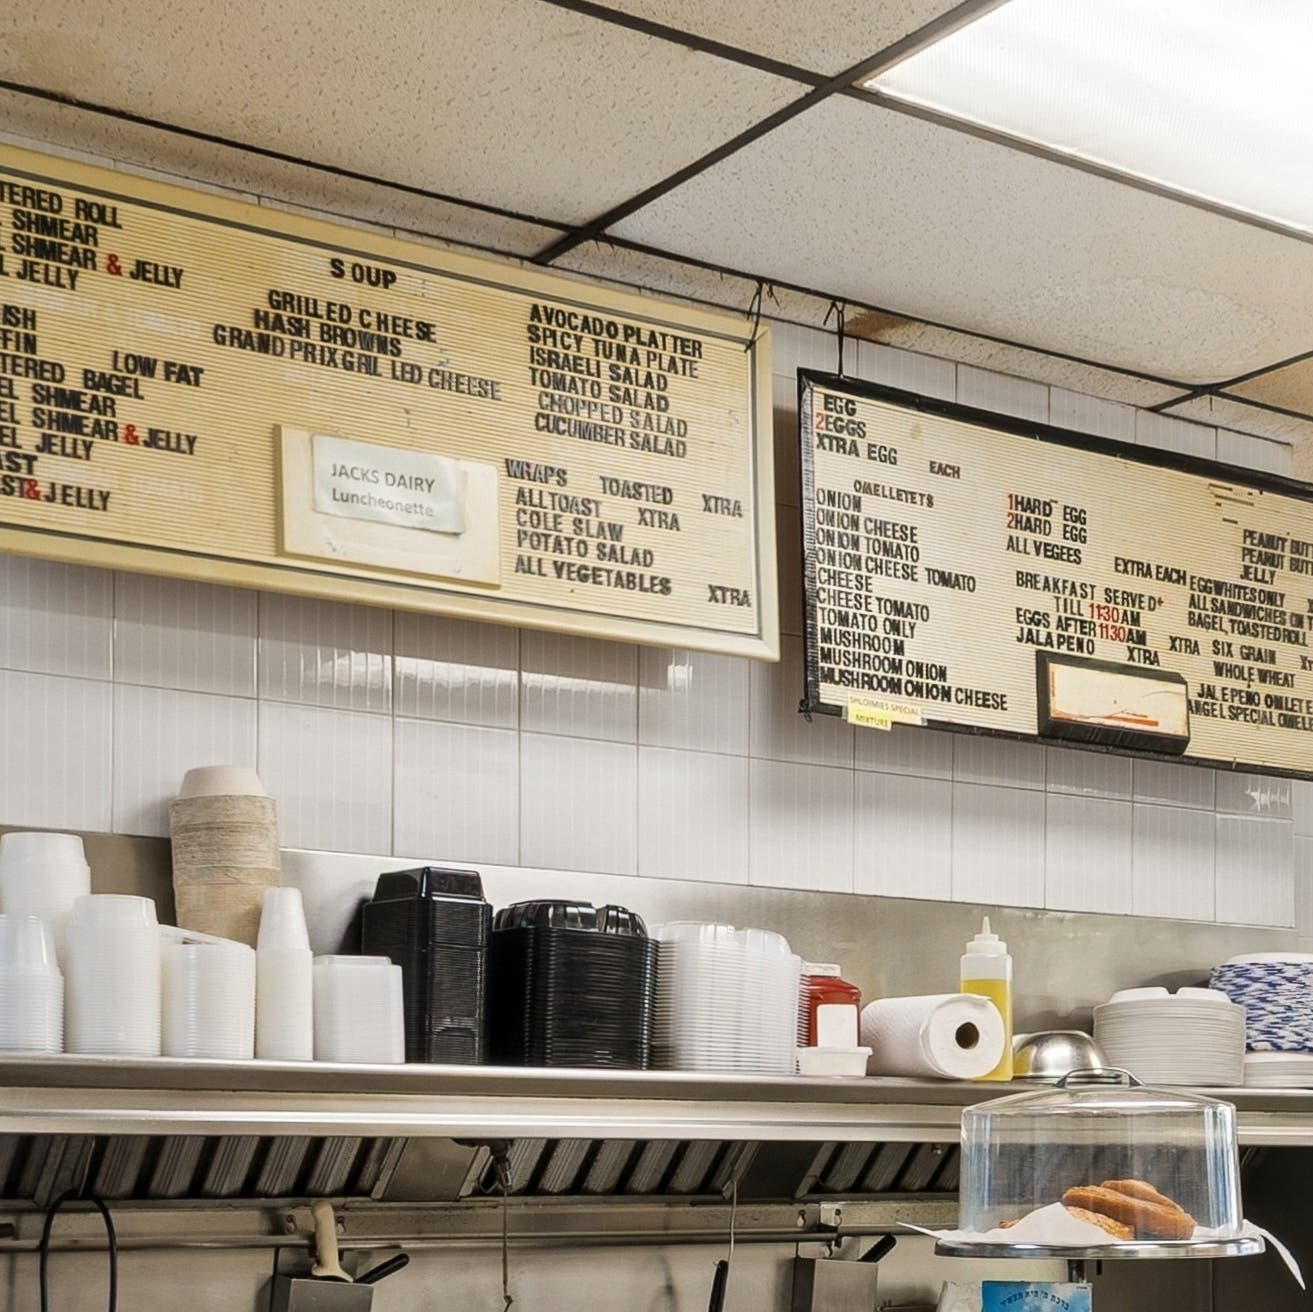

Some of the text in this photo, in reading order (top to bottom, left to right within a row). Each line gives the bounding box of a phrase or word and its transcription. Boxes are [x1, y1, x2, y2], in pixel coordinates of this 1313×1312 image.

[12, 209, 99, 247] SHMEAR
[74, 198, 123, 229] ROLL
[12, 233, 184, 289] SHMEAR & JELLY
[16, 259, 79, 290] JELLY
[330, 258, 397, 289] SOUP
[268, 289, 437, 343] GRILLED CHEESE
[530, 304, 703, 359] AVOCADO PLATTER
[253, 308, 402, 357] HASH BROWNS
[212, 324, 285, 358] GRAND
[289, 341, 338, 369] PRIX
[428, 368, 503, 401] CHEESE
[527, 324, 699, 379] SPICY TUNA PLATE
[83, 368, 145, 400] BAGEL
[112, 350, 204, 387] LOW FAT
[530, 346, 668, 392] ISRAELI SALAD
[32, 383, 117, 418] SHMEAR
[528, 367, 669, 413] TOMATO SALAD
[823, 393, 857, 417] EGG
[538, 391, 688, 438] CHOPPED SALAD
[32, 407, 119, 442] SHMEAR
[124, 424, 140, 445] &
[143, 427, 197, 455] JELLY
[36, 432, 94, 461] JELLY
[535, 412, 687, 458] CUCUMBER SALAD
[0, 451, 38, 475] ST
[816, 432, 898, 465] XTRA EGG
[331, 463, 435, 494] JACKS DAIRY
[929, 460, 960, 479] EACH
[45, 482, 110, 512] JELLY
[332, 487, 434, 518] Luncheonette
[599, 475, 672, 505] TOASTED
[702, 493, 743, 518] XTRA
[816, 487, 862, 512] ONION
[516, 508, 623, 543] COLE SLAW
[638, 507, 681, 532] XTRA
[816, 508, 918, 544] ONION CHEESE
[1063, 505, 1087, 526] EGG
[517, 529, 654, 568] POTATO SALAD
[815, 527, 919, 562] ONION TOMATO
[1006, 535, 1082, 565] ALL VEGEES
[1063, 523, 1087, 545] EGG
[1243, 529, 1287, 552] PEANUT
[816, 549, 976, 593] ONION CHEESE TOMATO
[1114, 556, 1187, 586] EXTRA EACH
[1242, 547, 1285, 569] PEANUT
[515, 554, 751, 608] ALL VEGETABLES XTRA
[817, 567, 872, 593] CHEESE
[1016, 570, 1157, 612] BREAKFAST SERVED
[1240, 565, 1276, 585] JELLY
[816, 587, 930, 622] CHEESE TOMATO
[1053, 596, 1084, 616] TILL
[1211, 597, 1286, 626] SANDWICHES
[818, 607, 916, 639] TOMATO ONLY
[1016, 607, 1050, 629] EGGS
[1056, 615, 1096, 637] AFTER
[820, 626, 905, 656] MUSHROOM
[1016, 627, 1160, 667] JALAPENO XTRA
[1169, 635, 1200, 655] XTRA
[1212, 639, 1234, 658] SIX
[1240, 645, 1277, 665] GRAIN
[820, 646, 947, 683] MUSHROOM ONION
[1213, 660, 1255, 682] WHOLE
[1257, 667, 1296, 689] WHEAT
[820, 666, 1008, 711] MUSHROOM ONION CHEESE
[855, 714, 888, 727] MIXTURE
[1228, 705, 1275, 726] SPECIAL
